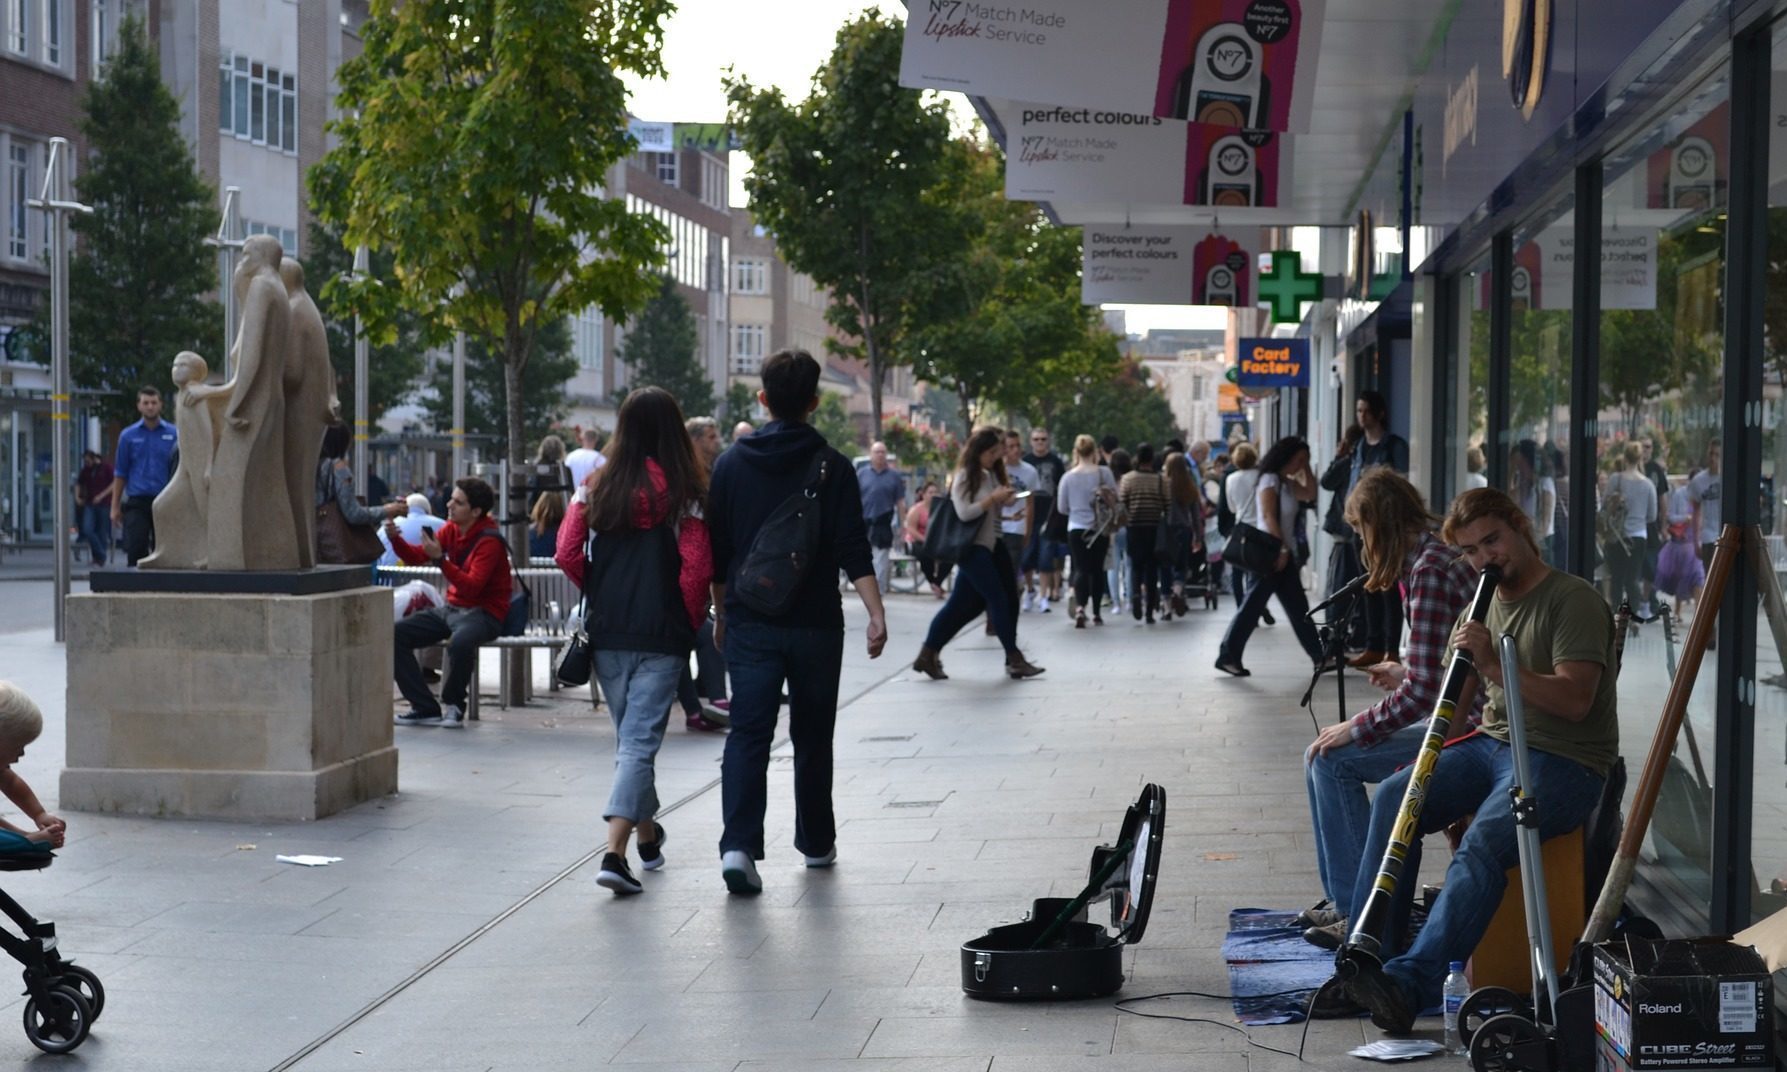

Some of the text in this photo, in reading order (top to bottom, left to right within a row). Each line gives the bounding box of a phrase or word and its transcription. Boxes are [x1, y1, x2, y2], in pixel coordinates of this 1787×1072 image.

[965, 3, 1016, 22] Match
[1020, 9, 1066, 28] Made
[1254, 3, 1285, 13] Another
[985, 24, 1046, 45] Service
[1022, 106, 1163, 126] perfect colours
[1046, 137, 1083, 148] Match
[1085, 138, 1117, 149] Made
[1062, 152, 1105, 162] Service
[1092, 232, 1172, 247] Discover your
[1092, 247, 1178, 259] perfect colours
[1253, 346, 1290, 361] Card
[1242, 360, 1300, 377] Factory
[1639, 1003, 1682, 1014] Roland
[1640, 1041, 1736, 1056] CUBE Street
[1640, 1058, 1662, 1067] Battery
[1688, 1057, 1708, 1065] Stereo
[1709, 1057, 1736, 1065] Amplifier
